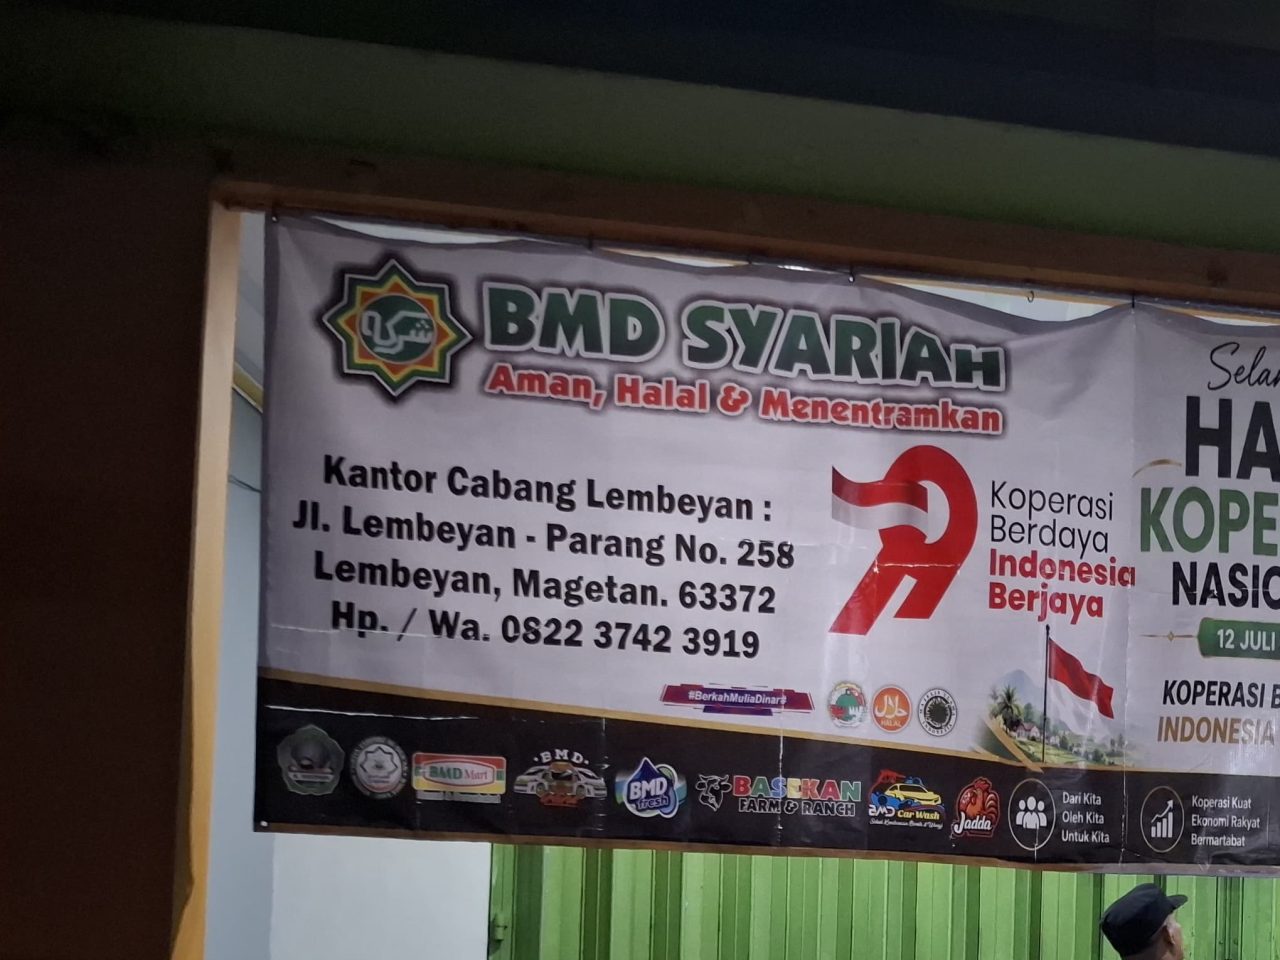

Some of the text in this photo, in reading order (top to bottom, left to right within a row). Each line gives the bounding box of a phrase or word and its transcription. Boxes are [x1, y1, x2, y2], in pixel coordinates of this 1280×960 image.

[485, 284, 1005, 390] BMD SYARIAH
[488, 366, 1001, 433] Aman, Halal & Menentramkan
[324, 455, 772, 522] Kantor Cabang Lembeyan :
[991, 481, 1114, 522] Koperasi
[293, 500, 329, 532] Jl.
[343, 506, 516, 551] Lembeyan
[547, 524, 666, 565] Parang
[675, 533, 728, 565] No.
[737, 539, 795, 569] 258
[991, 515, 1109, 560] Berdaya
[989, 549, 1136, 589] Indonesia
[314, 551, 776, 614] Lembeyan, Magetan. 63372
[989, 582, 1104, 626] Berjaya
[332, 601, 760, 659] Hp. / Wa. 0822 3742 3919
[1217, 629, 1235, 649] 12
[1240, 631, 1275, 651] JULI
[1162, 680, 1266, 708] KOPERASI
[1157, 716, 1275, 746] INDONESIA
[540, 749, 584, 764] BMD
[429, 766, 489, 781] BMD Mart
[629, 777, 668, 800] BMD
[1062, 791, 1102, 806] Dari Kita
[638, 796, 668, 810] fresh
[739, 798, 856, 817] FARM & RANCH
[1191, 795, 1252, 810] Koperasi Kuat
[897, 810, 914, 819] Car
[915, 811, 940, 820] Wash
[954, 811, 993, 834] Jadda
[1062, 811, 1104, 825] Oleh Kita
[1191, 814, 1260, 830] Ekonomi Rakyat
[1061, 829, 1110, 844] Untuk Kita
[1191, 833, 1246, 847] Bermartabat
